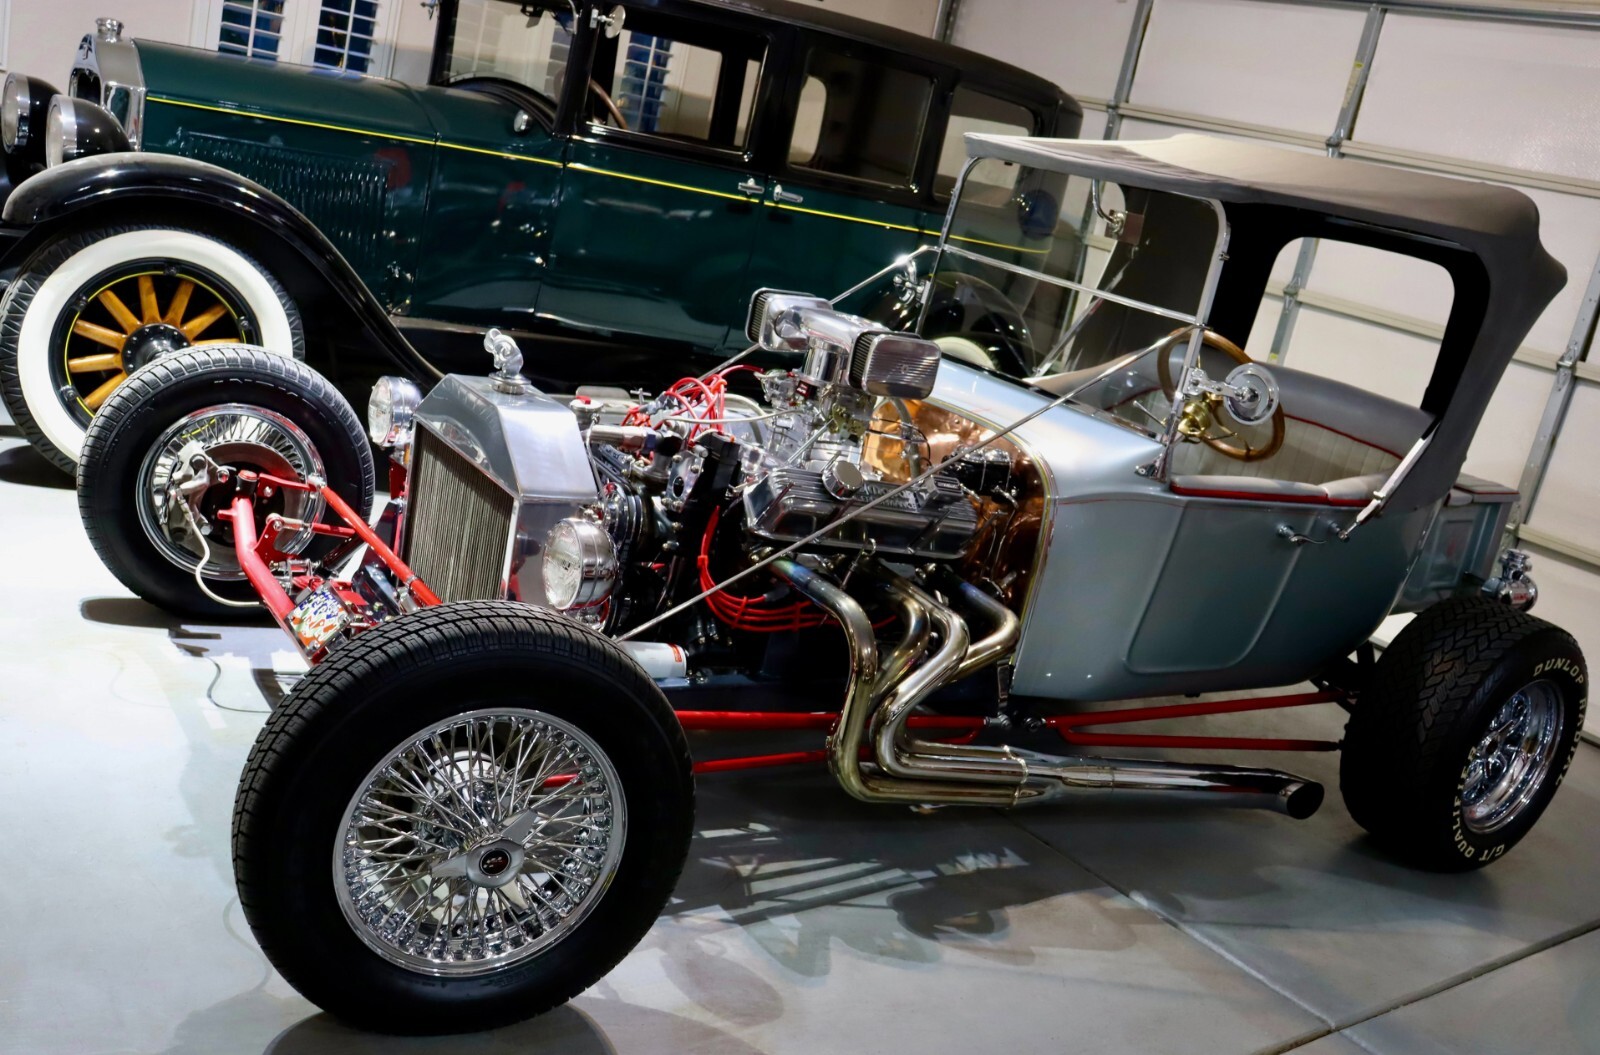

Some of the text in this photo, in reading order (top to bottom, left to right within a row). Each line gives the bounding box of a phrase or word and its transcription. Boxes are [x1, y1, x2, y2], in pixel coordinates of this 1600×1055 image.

[1533, 658, 1584, 684] DUNLOP
[1556, 698, 1587, 786] RADIAL
[1479, 844, 1505, 861] G/T
